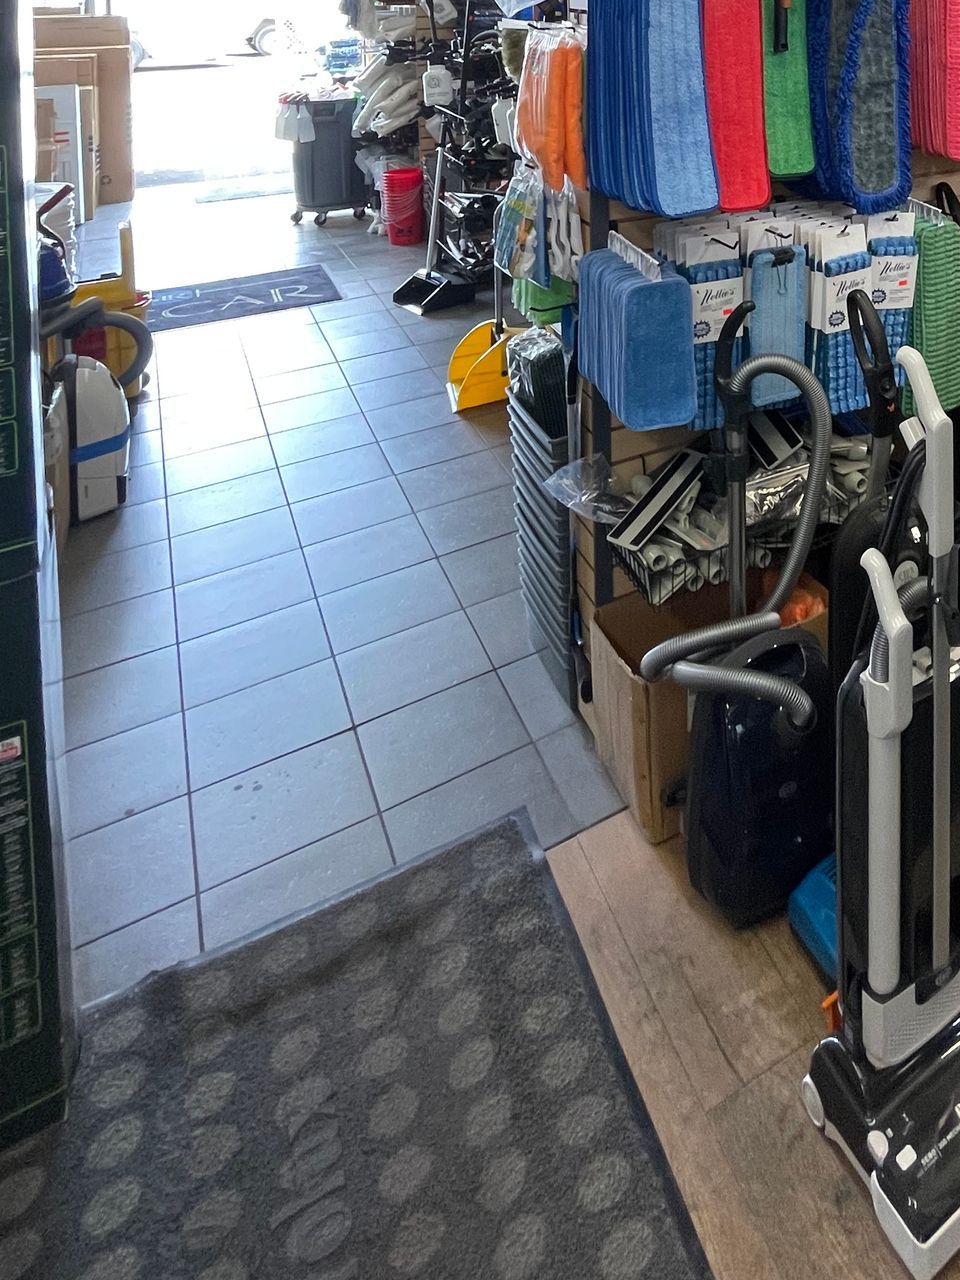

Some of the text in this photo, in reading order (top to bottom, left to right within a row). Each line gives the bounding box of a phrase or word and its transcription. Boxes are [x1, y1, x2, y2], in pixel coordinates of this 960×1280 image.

[879, 260, 911, 275] Nellie's
[160, 284, 324, 319] CAR
[700, 287, 736, 306] Nellie's
